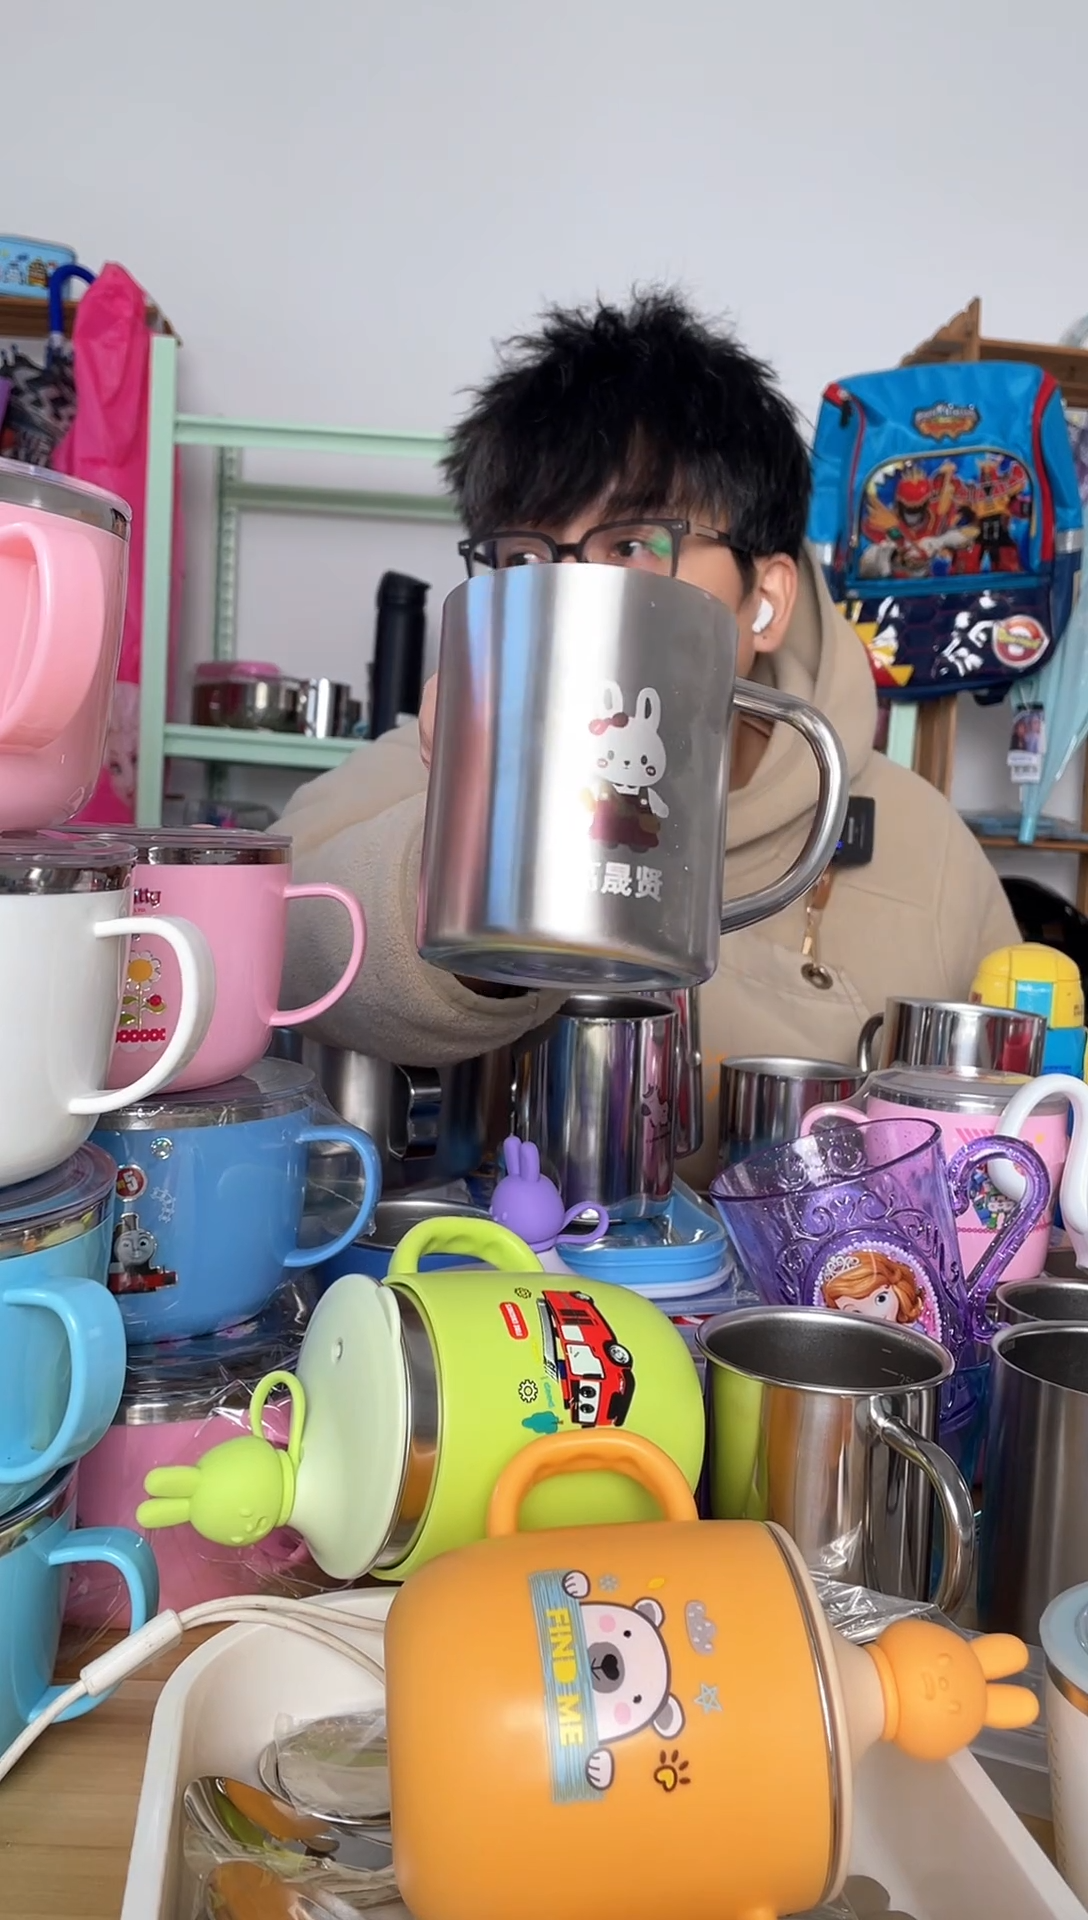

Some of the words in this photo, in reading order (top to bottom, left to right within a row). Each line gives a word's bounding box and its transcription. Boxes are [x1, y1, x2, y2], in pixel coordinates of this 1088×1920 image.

[134, 888, 162, 908] itty
[123, 1170, 139, 1192] 5
[545, 1607, 578, 1685] FIND
[556, 1693, 584, 1747] ME
